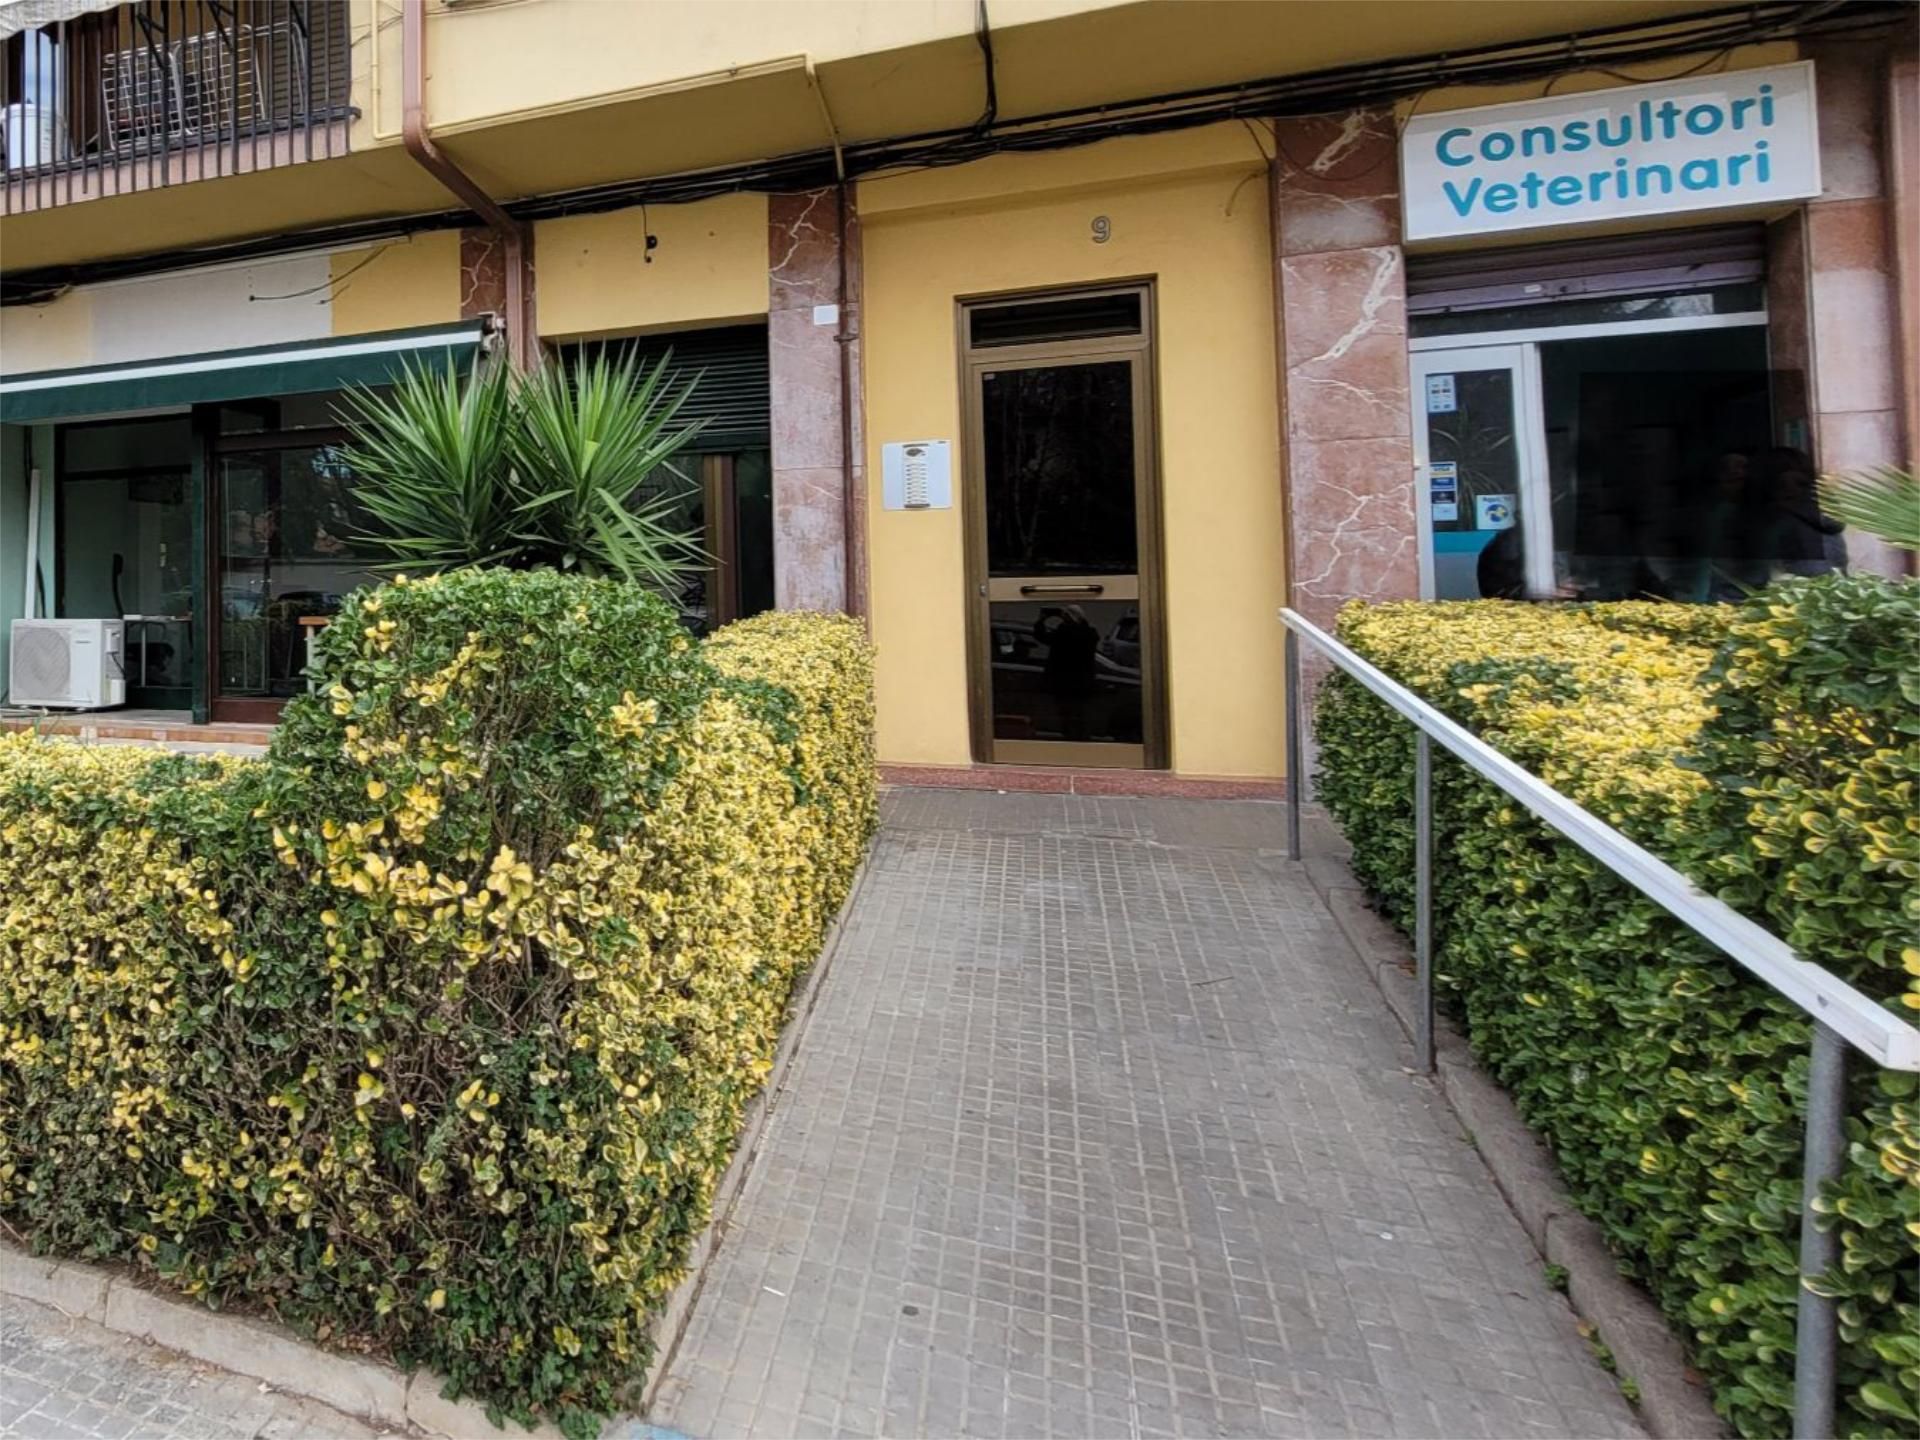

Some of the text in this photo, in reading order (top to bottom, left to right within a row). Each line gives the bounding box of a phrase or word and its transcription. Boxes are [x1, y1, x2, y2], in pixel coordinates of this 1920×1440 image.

[1435, 84, 1775, 167] Consultori
[1442, 140, 1772, 217] Veterinari
[1091, 215, 1111, 244] 9
